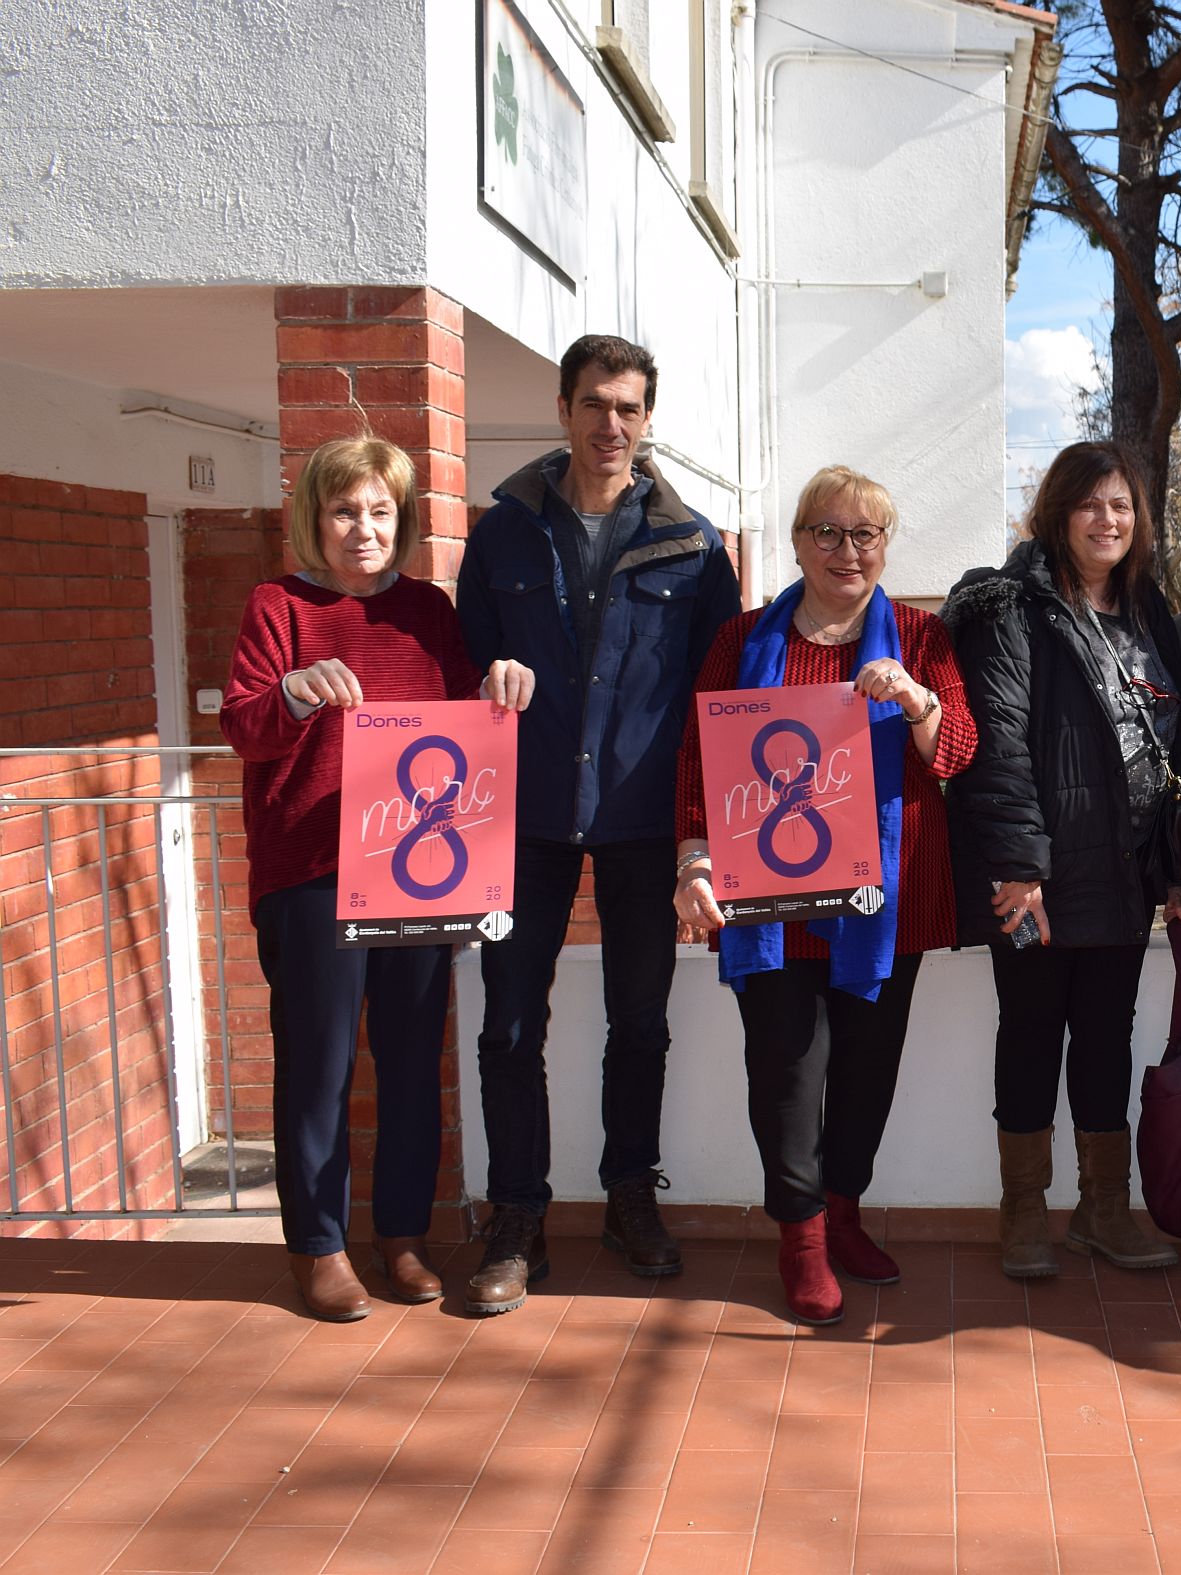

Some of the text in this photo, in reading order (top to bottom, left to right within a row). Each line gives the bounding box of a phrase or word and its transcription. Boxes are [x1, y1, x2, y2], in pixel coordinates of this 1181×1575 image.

[193, 463, 215, 486] 11A
[709, 702, 771, 716] Dones
[356, 714, 422, 728] Dones
[725, 748, 852, 825] març
[361, 768, 497, 842] març
[751, 718, 832, 879] 8
[391, 735, 469, 901] 8
[853, 861, 869, 869] 20
[486, 885, 502, 893] 20
[724, 881, 740, 889] 03
[350, 900, 367, 908] 03
[486, 893, 501, 901] 20
